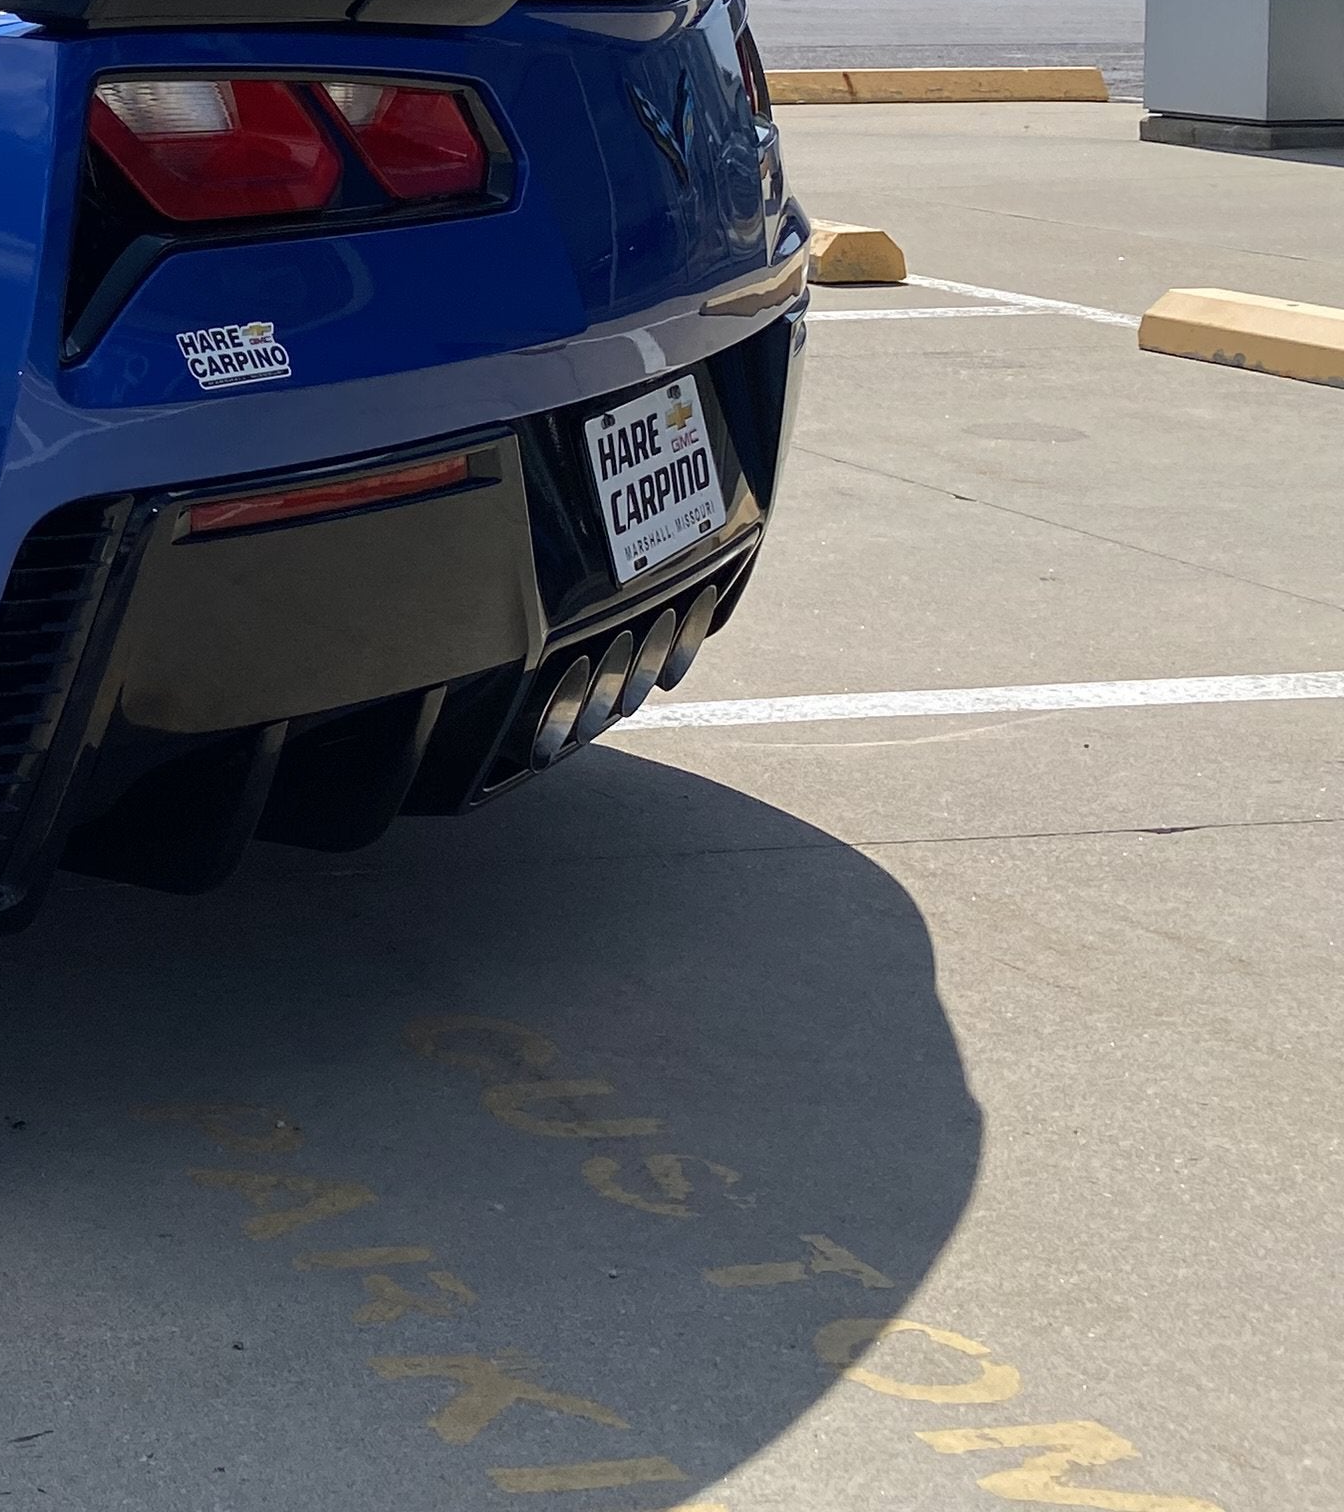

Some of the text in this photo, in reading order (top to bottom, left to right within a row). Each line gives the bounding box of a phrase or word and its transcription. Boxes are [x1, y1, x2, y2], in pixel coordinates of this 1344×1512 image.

[179, 327, 244, 356] HARE
[190, 345, 288, 378] CARPINO
[598, 412, 662, 481] HARE
[671, 428, 700, 453] GMC
[610, 446, 710, 536] CARPINO
[675, 500, 716, 532] MISSOURI
